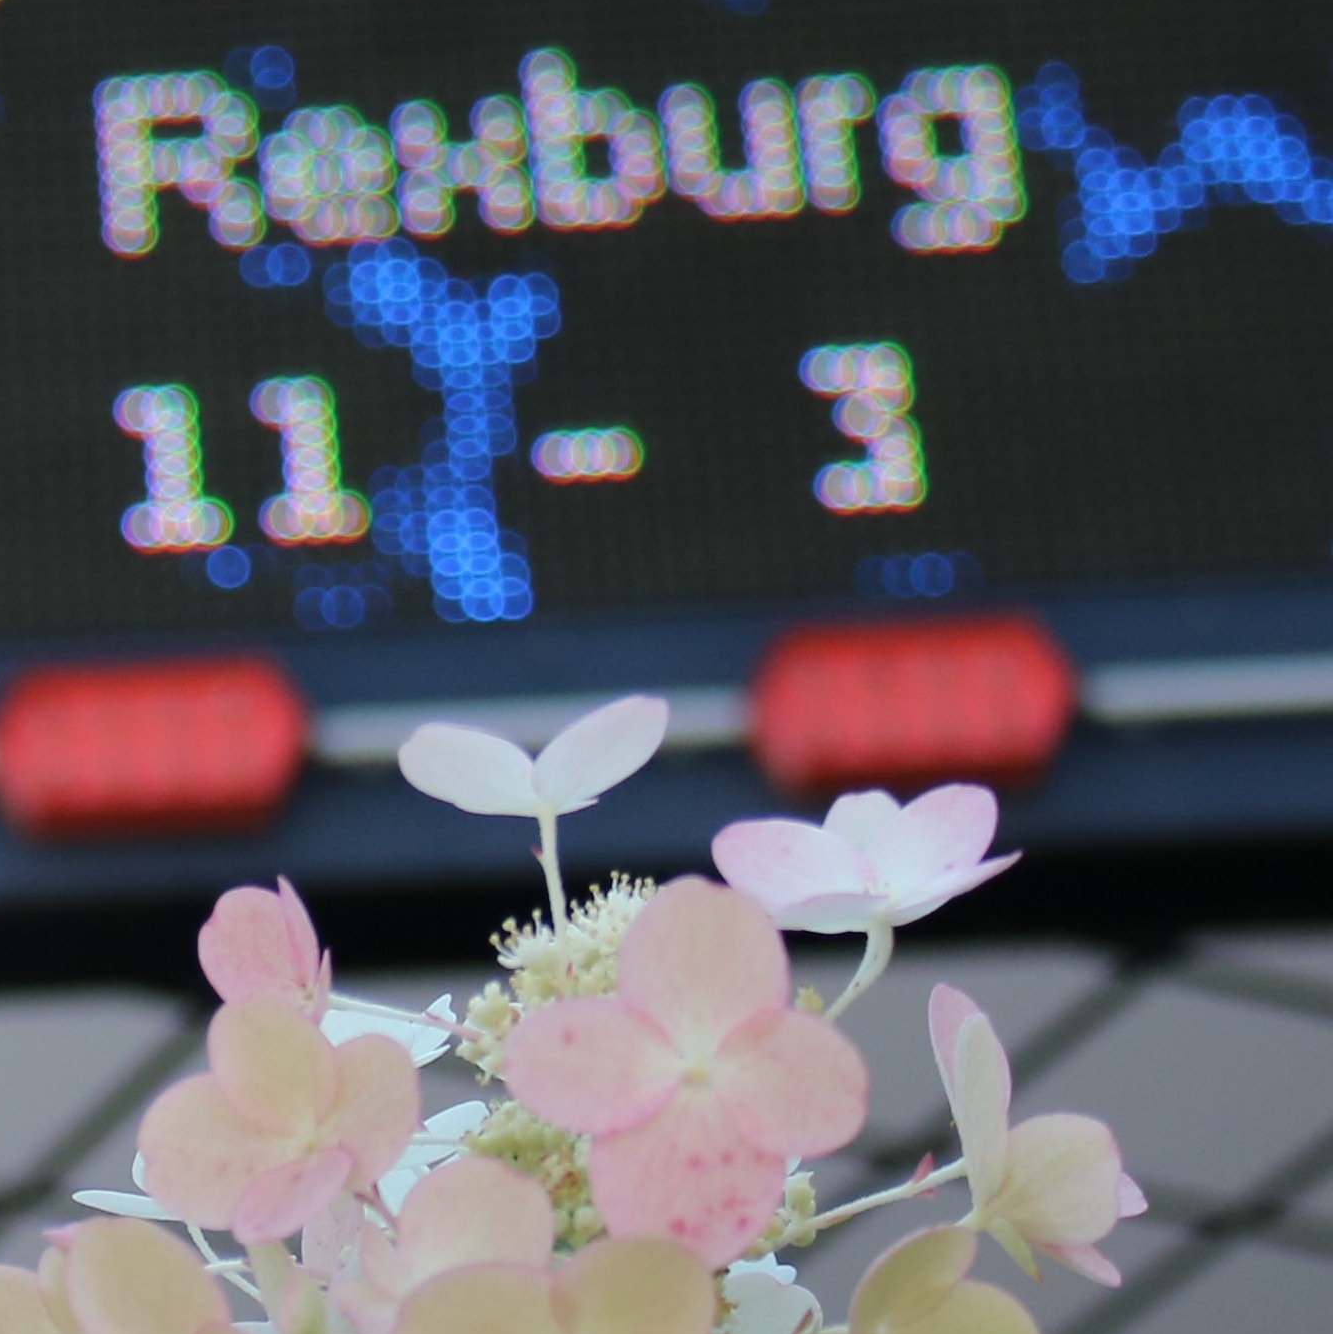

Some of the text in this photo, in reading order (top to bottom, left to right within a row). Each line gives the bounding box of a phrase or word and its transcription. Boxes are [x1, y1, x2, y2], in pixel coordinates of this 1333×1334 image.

[93, 47, 1026, 255] Rexburg
[112, 376, 371, 552] 11
[798, 341, 927, 514] 3
